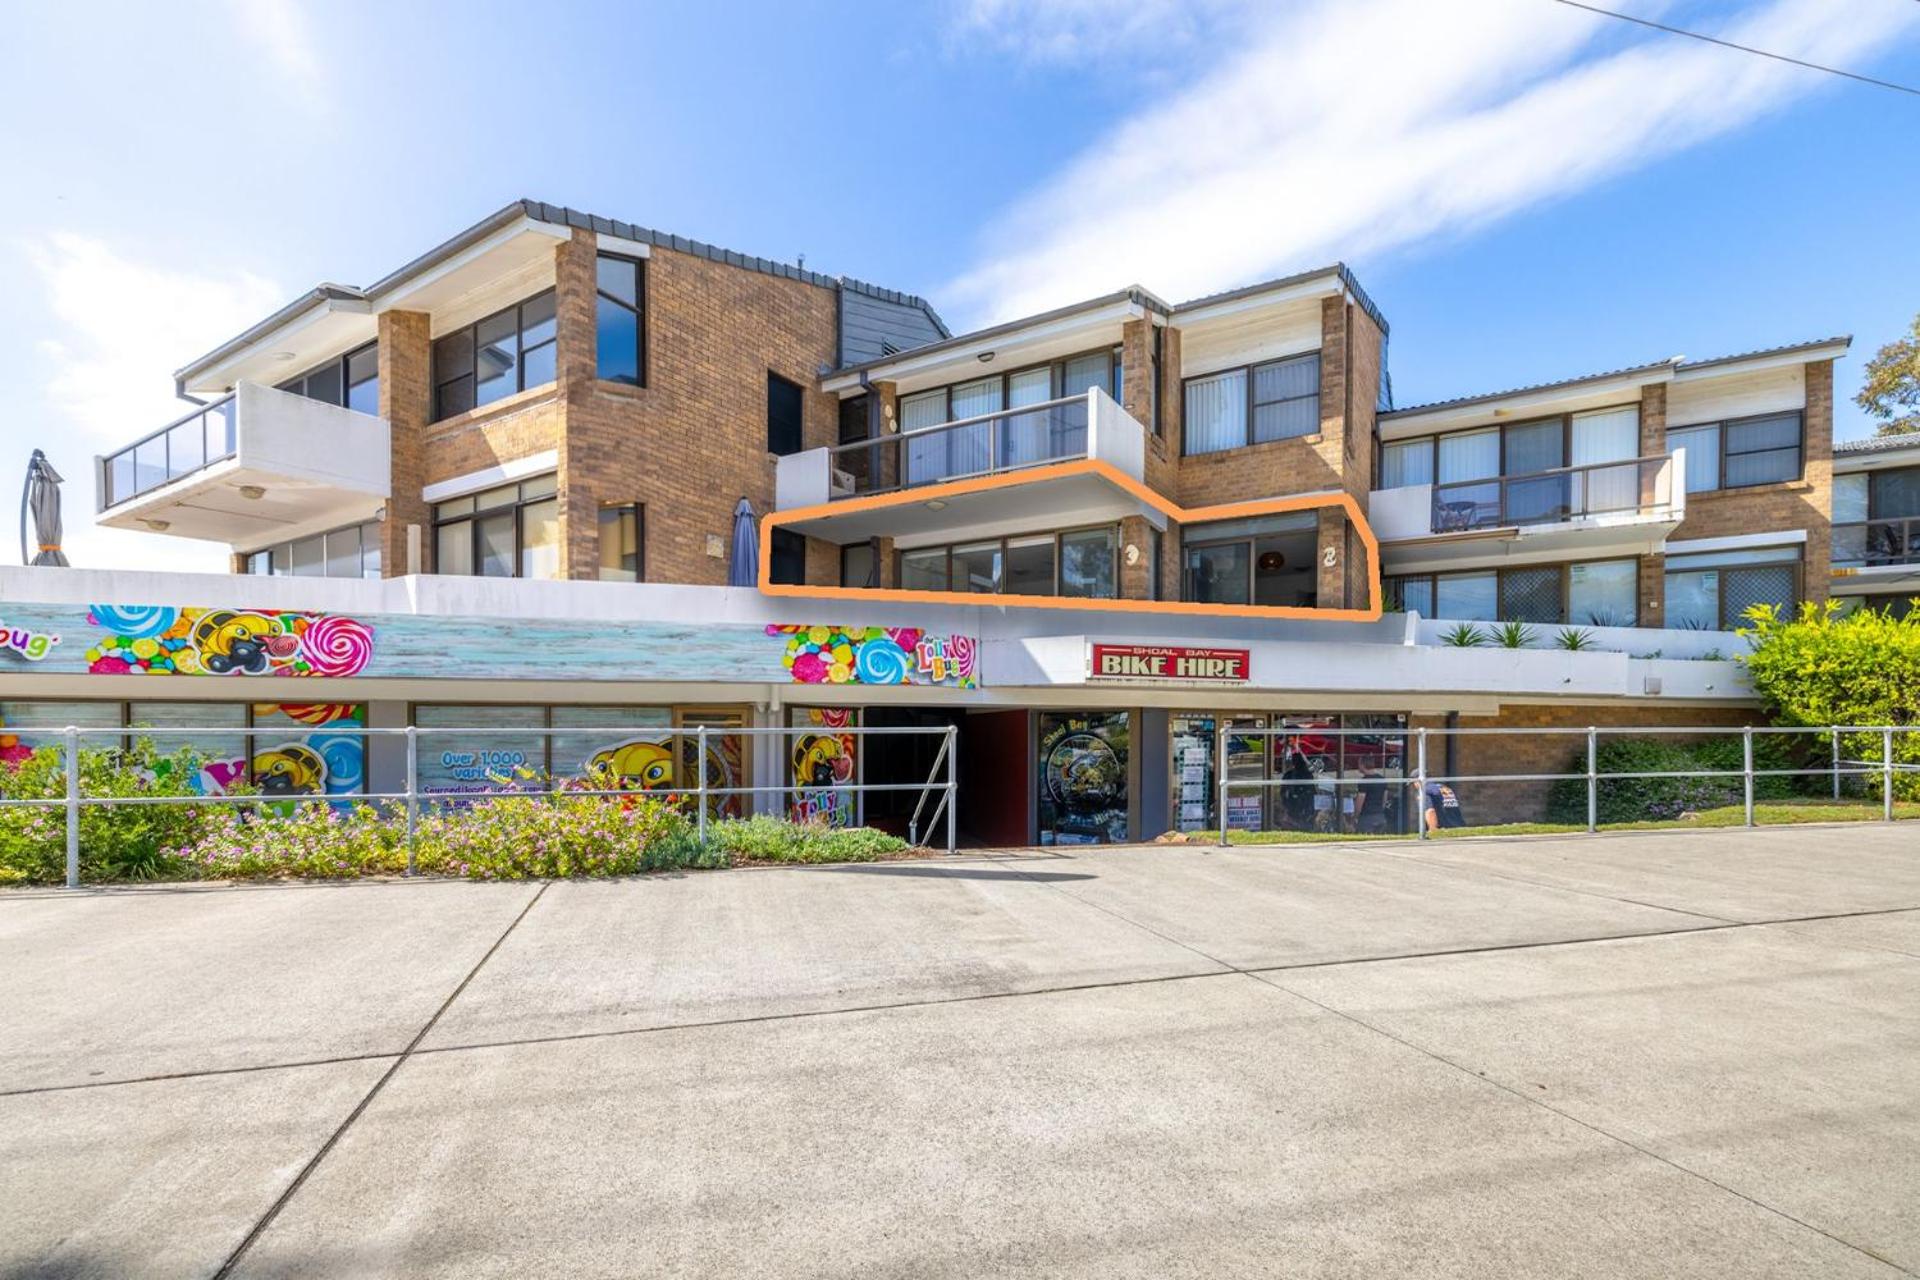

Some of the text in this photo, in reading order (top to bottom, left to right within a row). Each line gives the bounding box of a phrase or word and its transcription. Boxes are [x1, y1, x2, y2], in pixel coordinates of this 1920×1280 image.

[1185, 649, 1212, 657] BAY
[1101, 654, 1168, 676] BIKE
[1176, 657, 1241, 678] HIRE
[441, 750, 474, 767] Over
